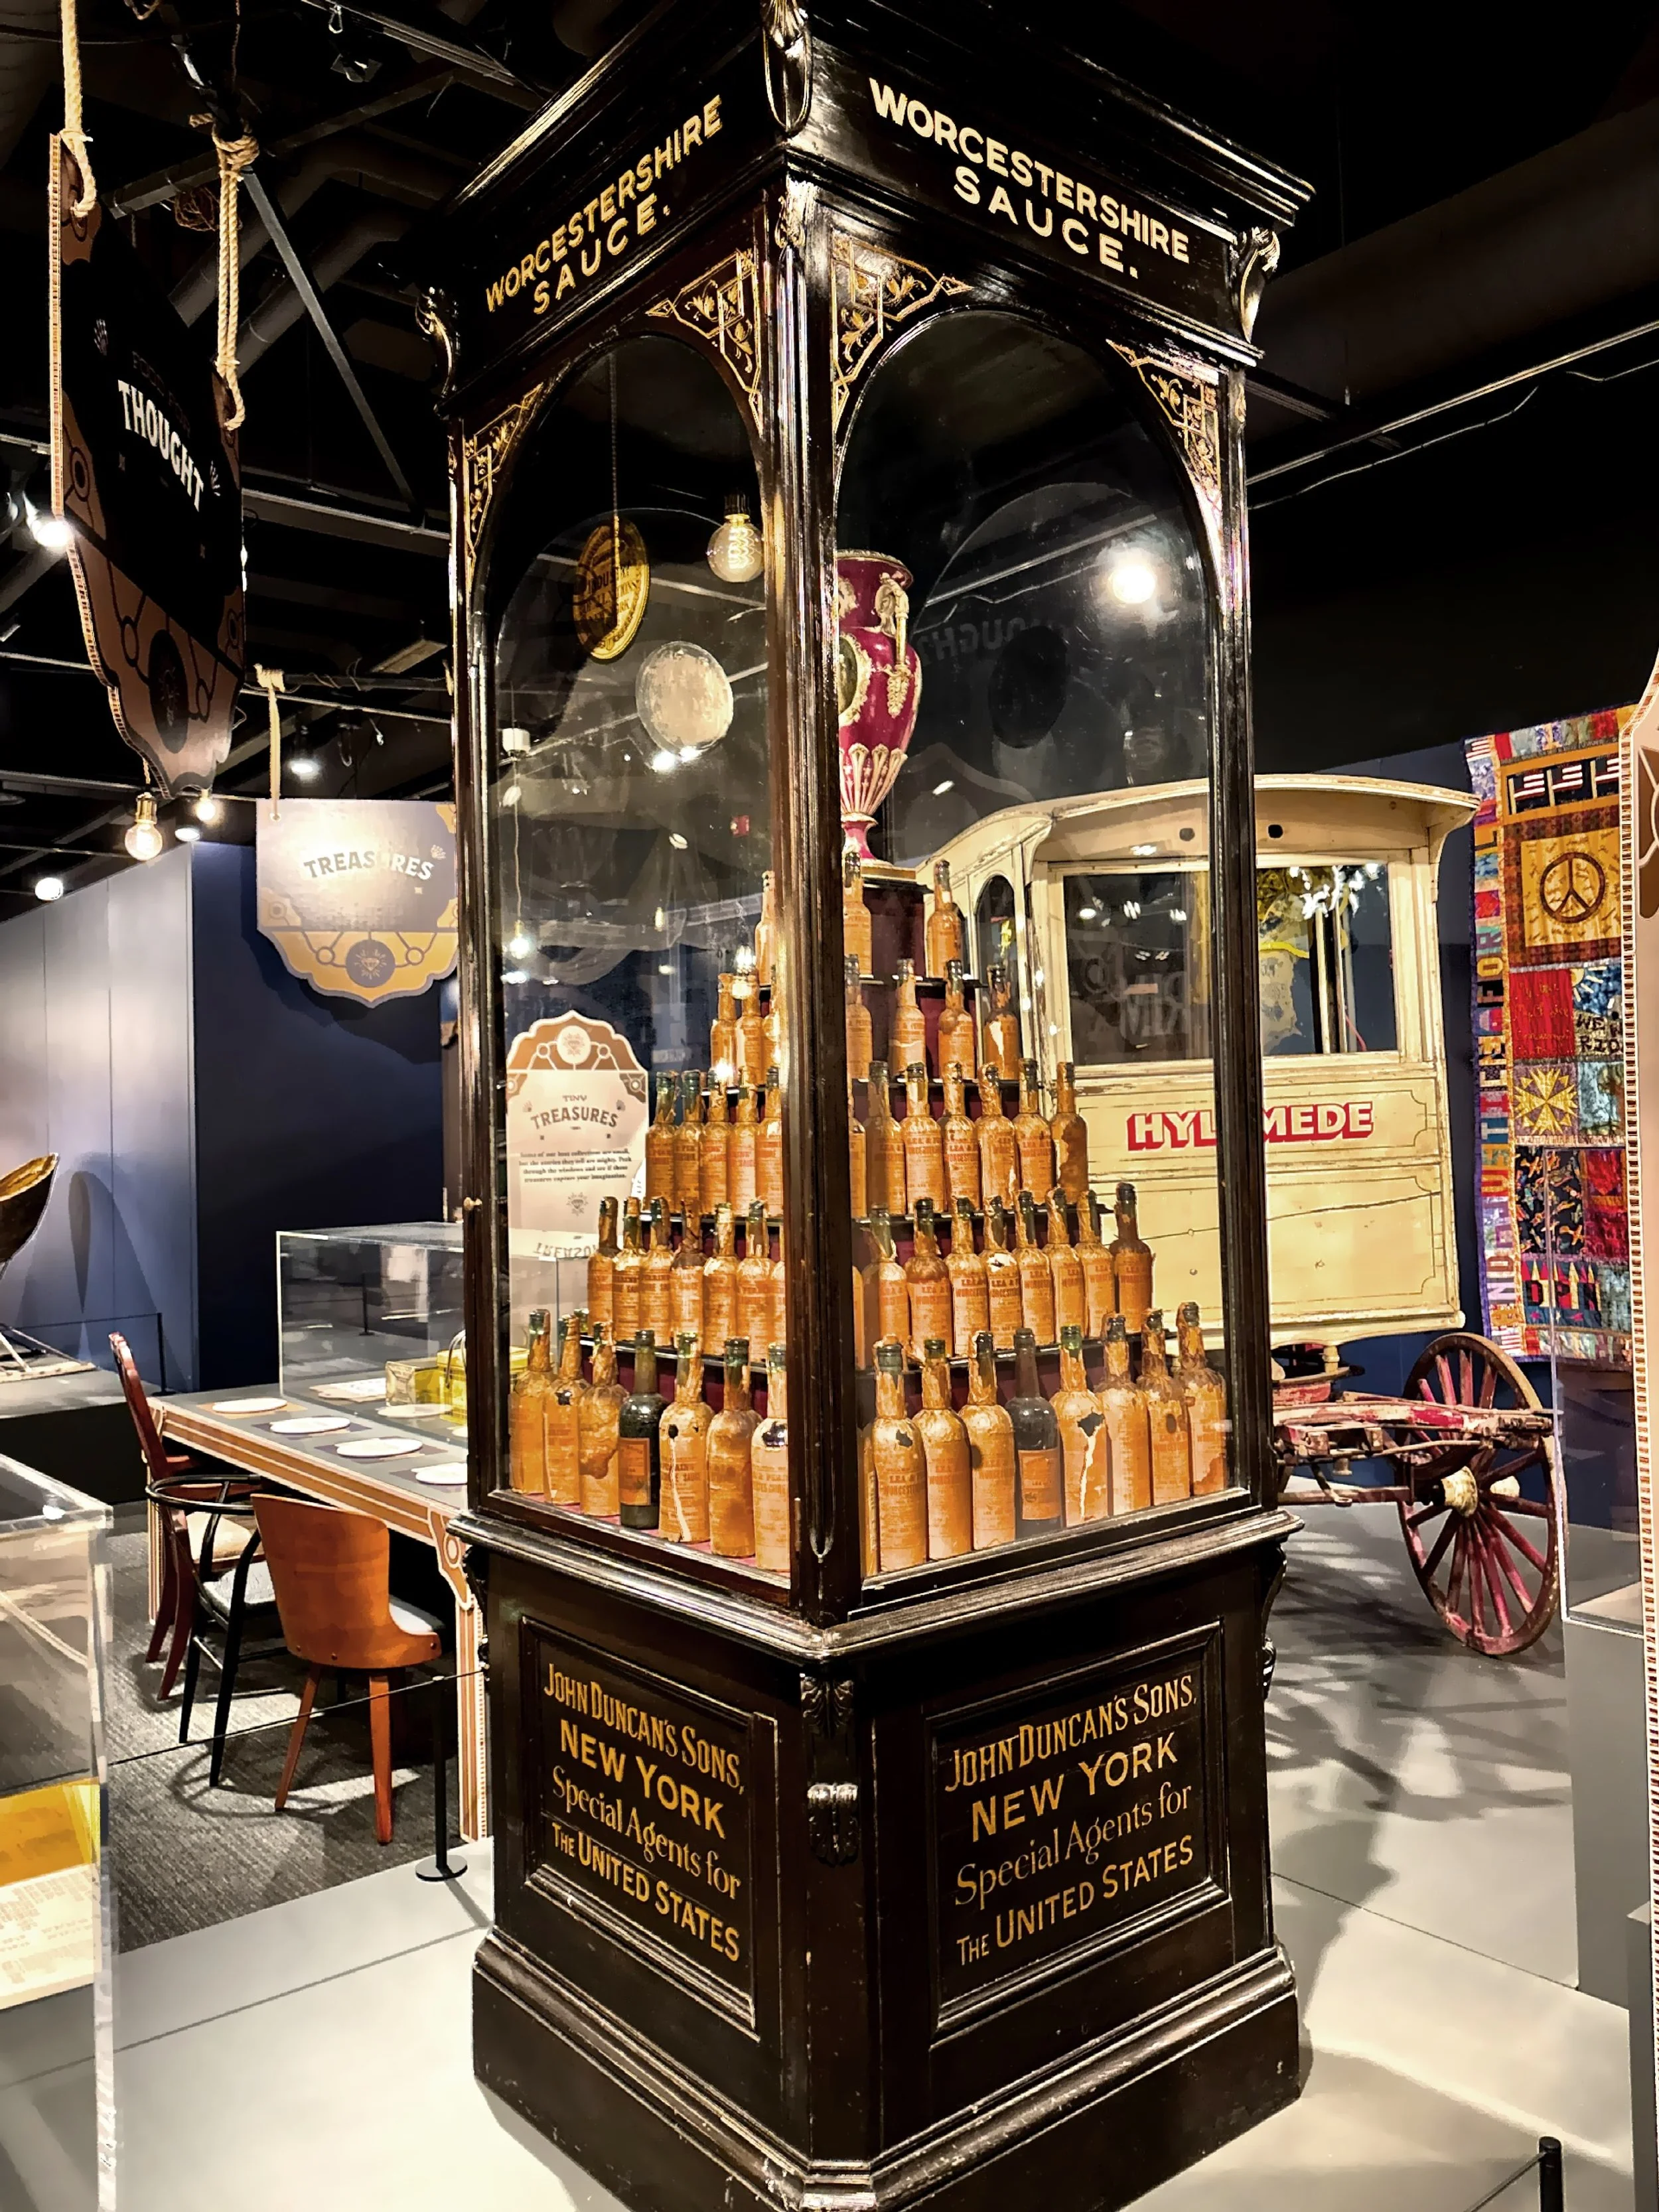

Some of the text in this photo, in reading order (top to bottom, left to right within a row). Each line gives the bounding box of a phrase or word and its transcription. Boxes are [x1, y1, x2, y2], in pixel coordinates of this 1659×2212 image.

[486, 94, 723, 312] WORCESTERSHIRE
[869, 78, 1190, 264] WORCESTERSHIRE
[954, 167, 1139, 279] SAUCE.
[534, 194, 671, 314] SAUCE.
[117, 380, 204, 512] THOUGHT
[531, 1106, 618, 1129] TREASURES
[544, 1663, 744, 1795] JOHN DUNCAN'S SONS,
[561, 1719, 727, 1839] NEW YORK
[945, 1736, 1014, 1791] JOHN
[1018, 1693, 1129, 1767] DUNCAN'S
[972, 1731, 1178, 1843] NEW YORK
[552, 1822, 740, 1962] THE UNITED STATES
[553, 1765, 741, 1900] Special Agents for
[955, 1780, 1192, 1911] Special Agents for
[956, 1834, 1194, 1966] THE UNITED STATES
